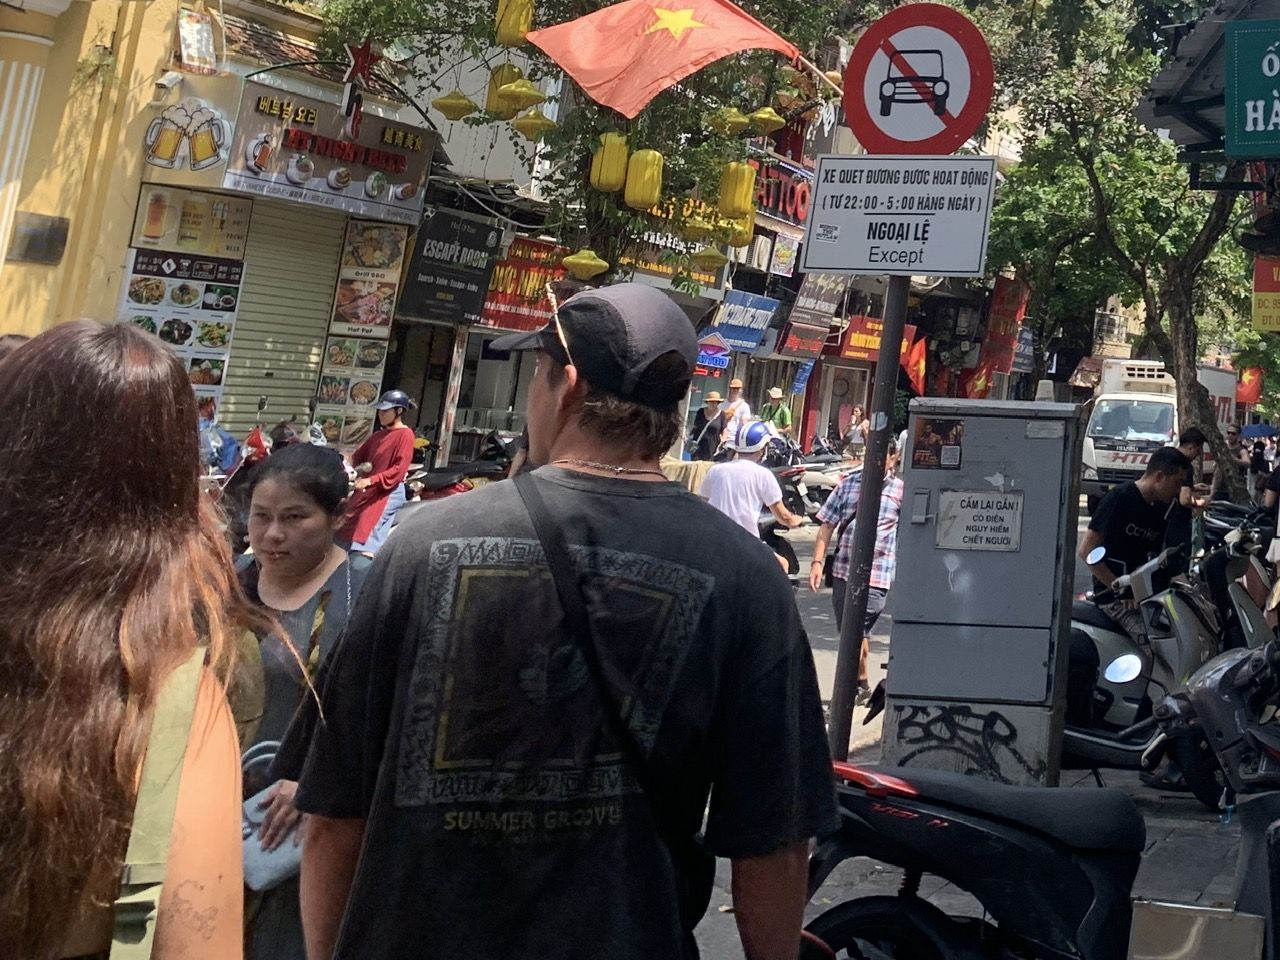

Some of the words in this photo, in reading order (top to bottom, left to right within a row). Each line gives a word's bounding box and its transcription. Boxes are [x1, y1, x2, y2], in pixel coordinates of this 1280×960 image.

[822, 169, 836, 183] XE
[961, 167, 988, 188] ĐỘNG
[748, 159, 811, 221] ATTOO
[844, 195, 878, 209] 22:00
[867, 222, 911, 244] NGOẠI
[913, 219, 930, 245] LỆ
[423, 239, 461, 263] ESCAPE
[460, 247, 489, 269] ROOM
[868, 246, 924, 267] Except
[980, 500, 994, 512] LẠI
